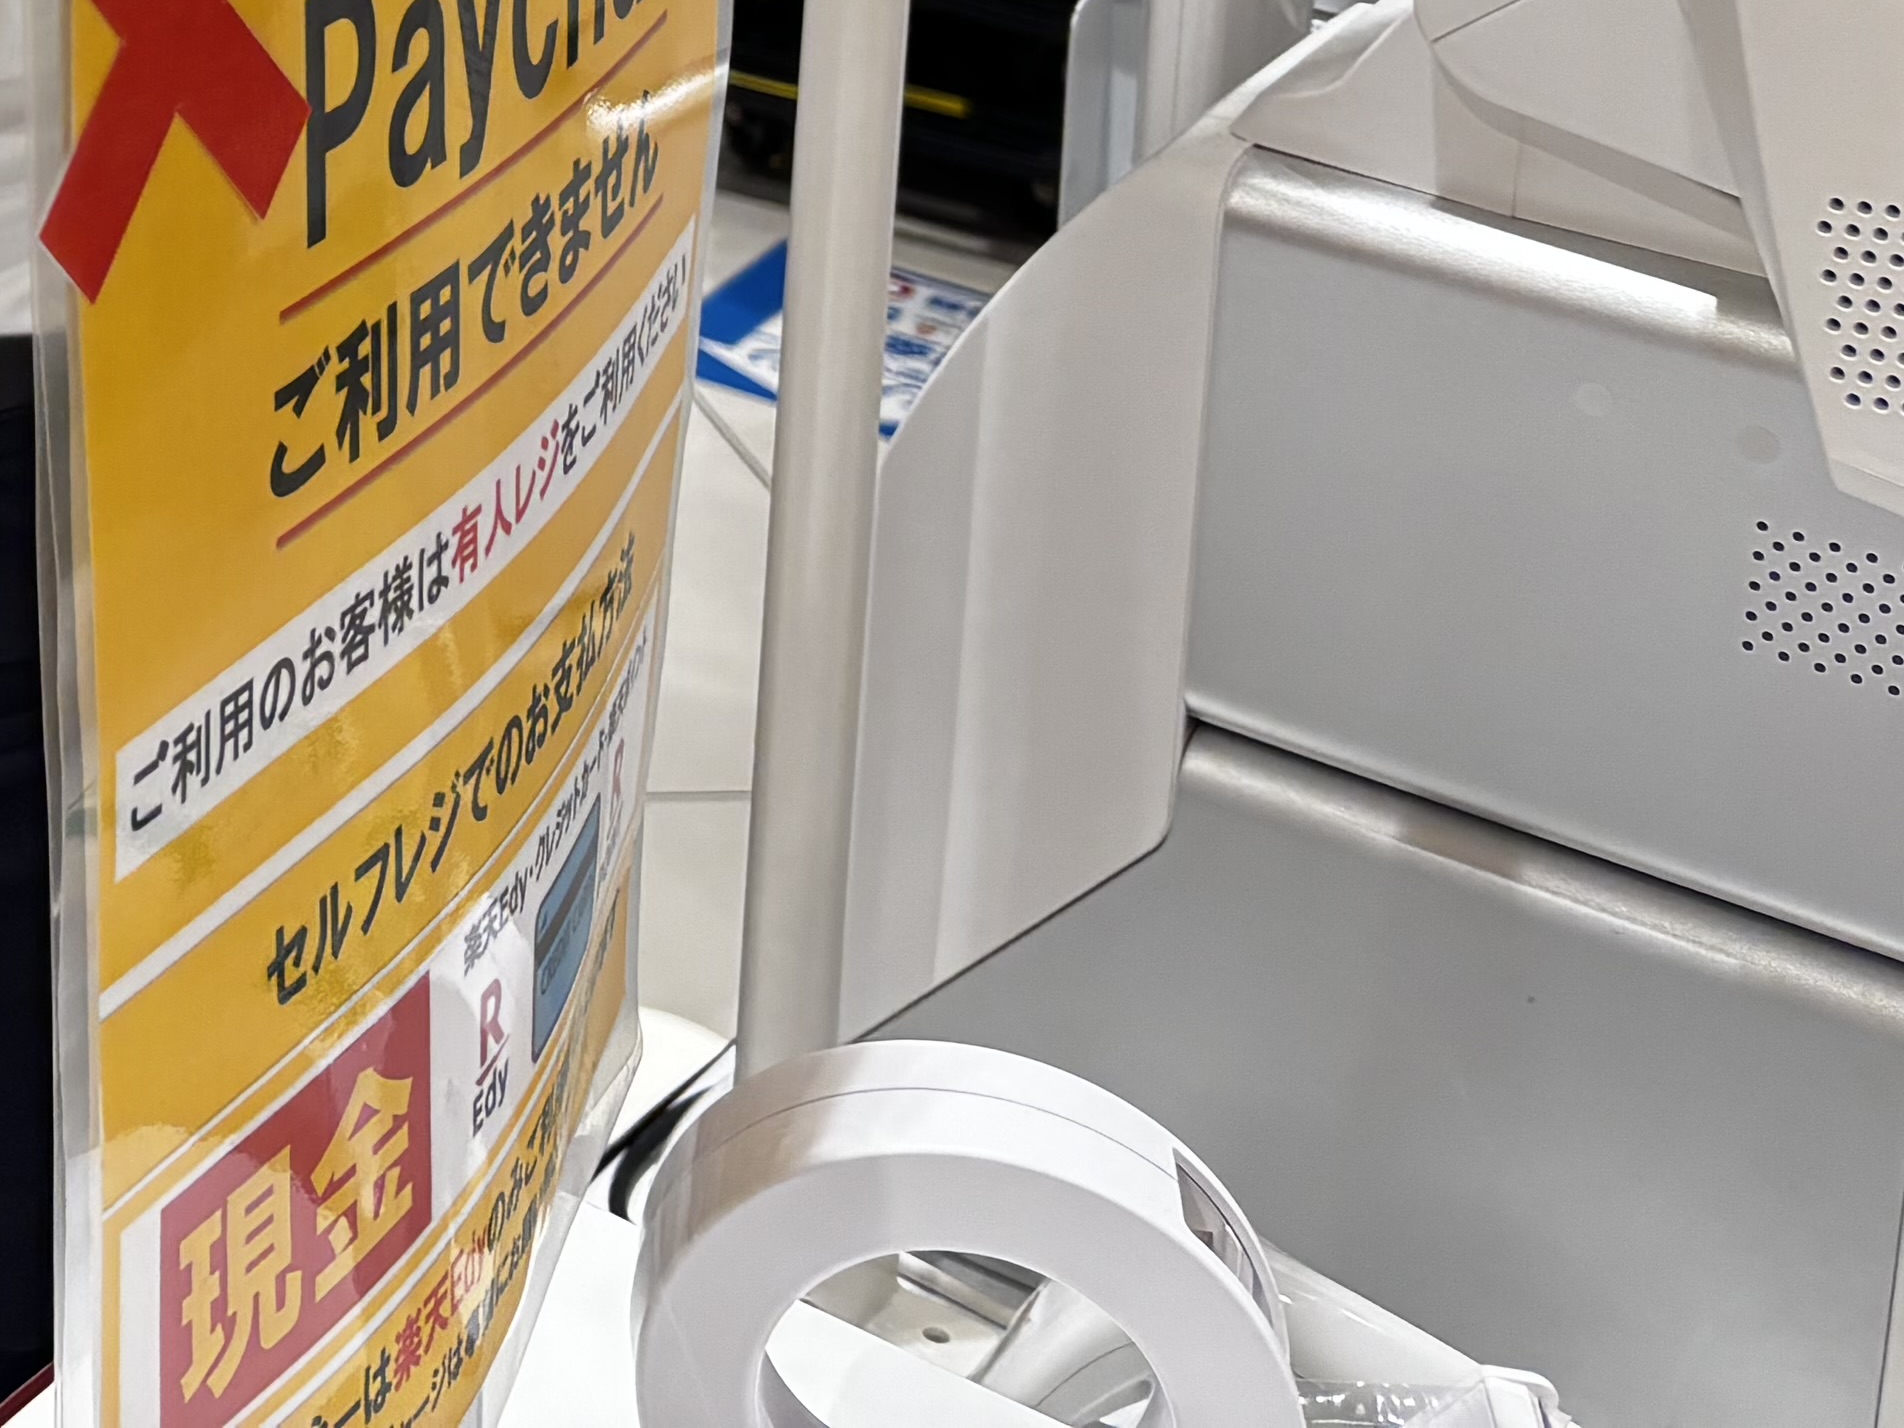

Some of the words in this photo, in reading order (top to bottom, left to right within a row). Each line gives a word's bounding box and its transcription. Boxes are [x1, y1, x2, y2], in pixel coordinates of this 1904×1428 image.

[268, 88, 660, 499] ご利用できません
[129, 252, 688, 834] ご利用のお客様は有人レジをご利用ください
[178, 1066, 415, 1404] 現金
[472, 1058, 510, 1139] Edy
